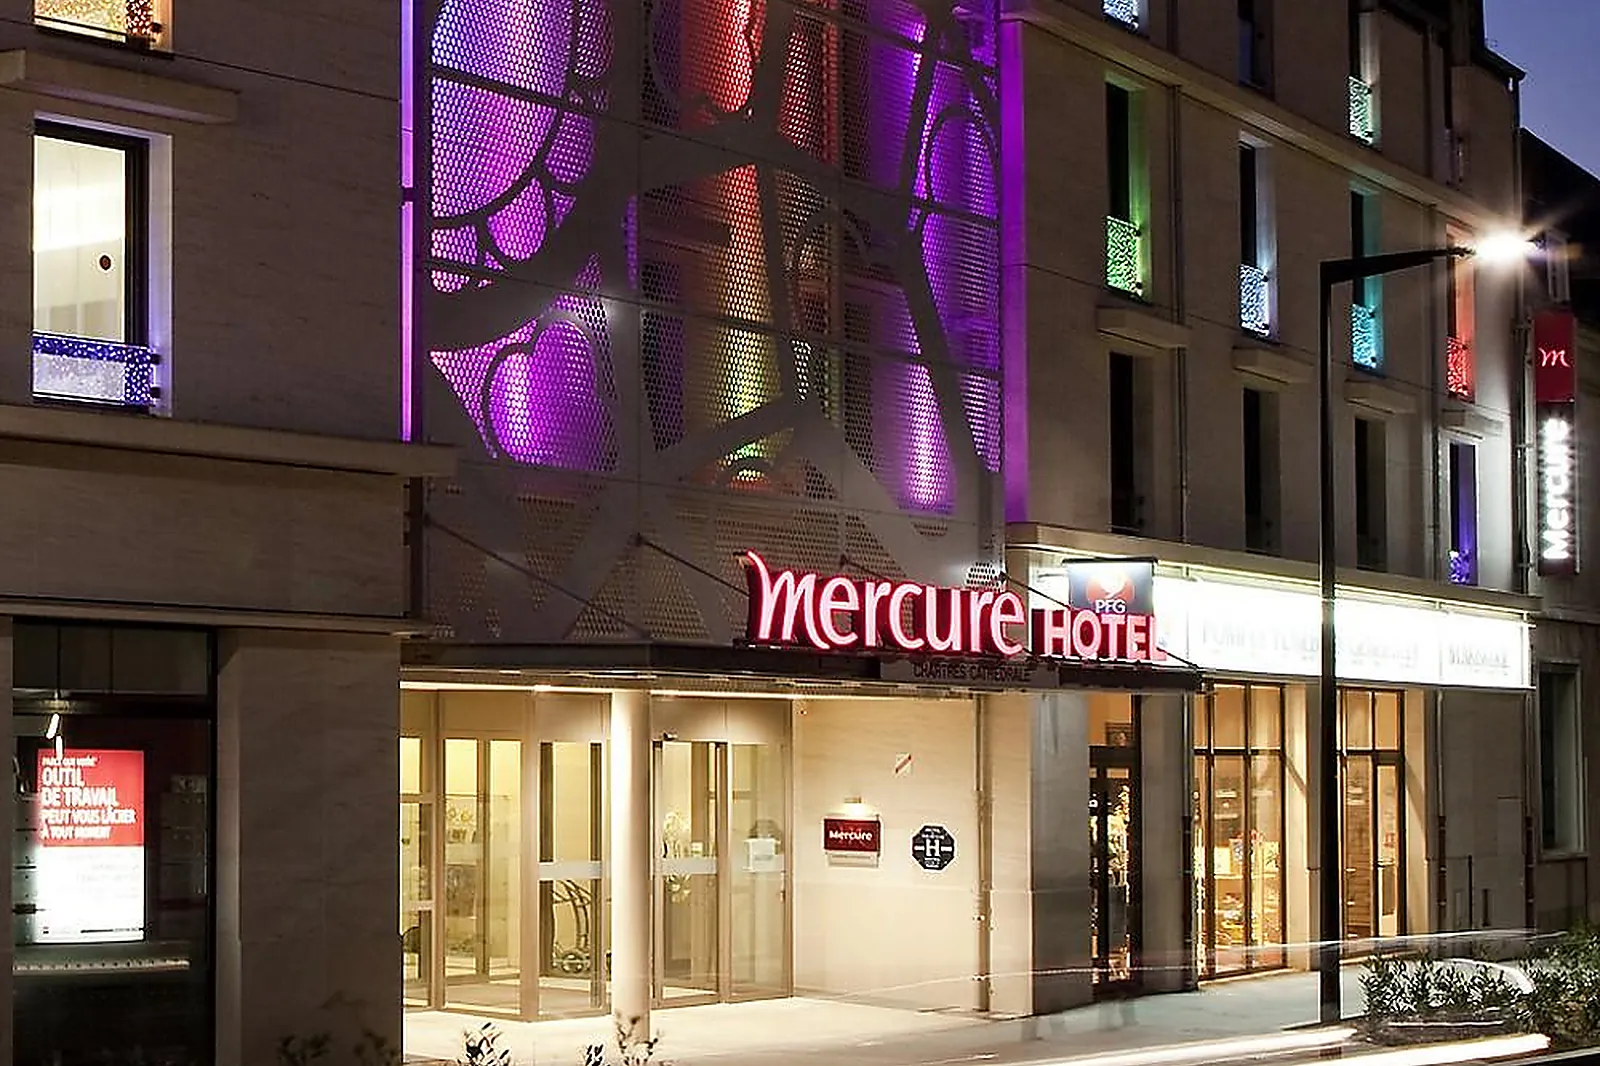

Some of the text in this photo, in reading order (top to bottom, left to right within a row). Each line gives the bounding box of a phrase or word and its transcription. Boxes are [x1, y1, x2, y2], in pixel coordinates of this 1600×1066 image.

[1094, 599, 1127, 614] PFG
[1043, 608, 1167, 662] HOTEL
[912, 662, 967, 679] CHARTRES
[42, 767, 86, 787] OUTIL
[41, 787, 120, 807] DE TRAVAIL
